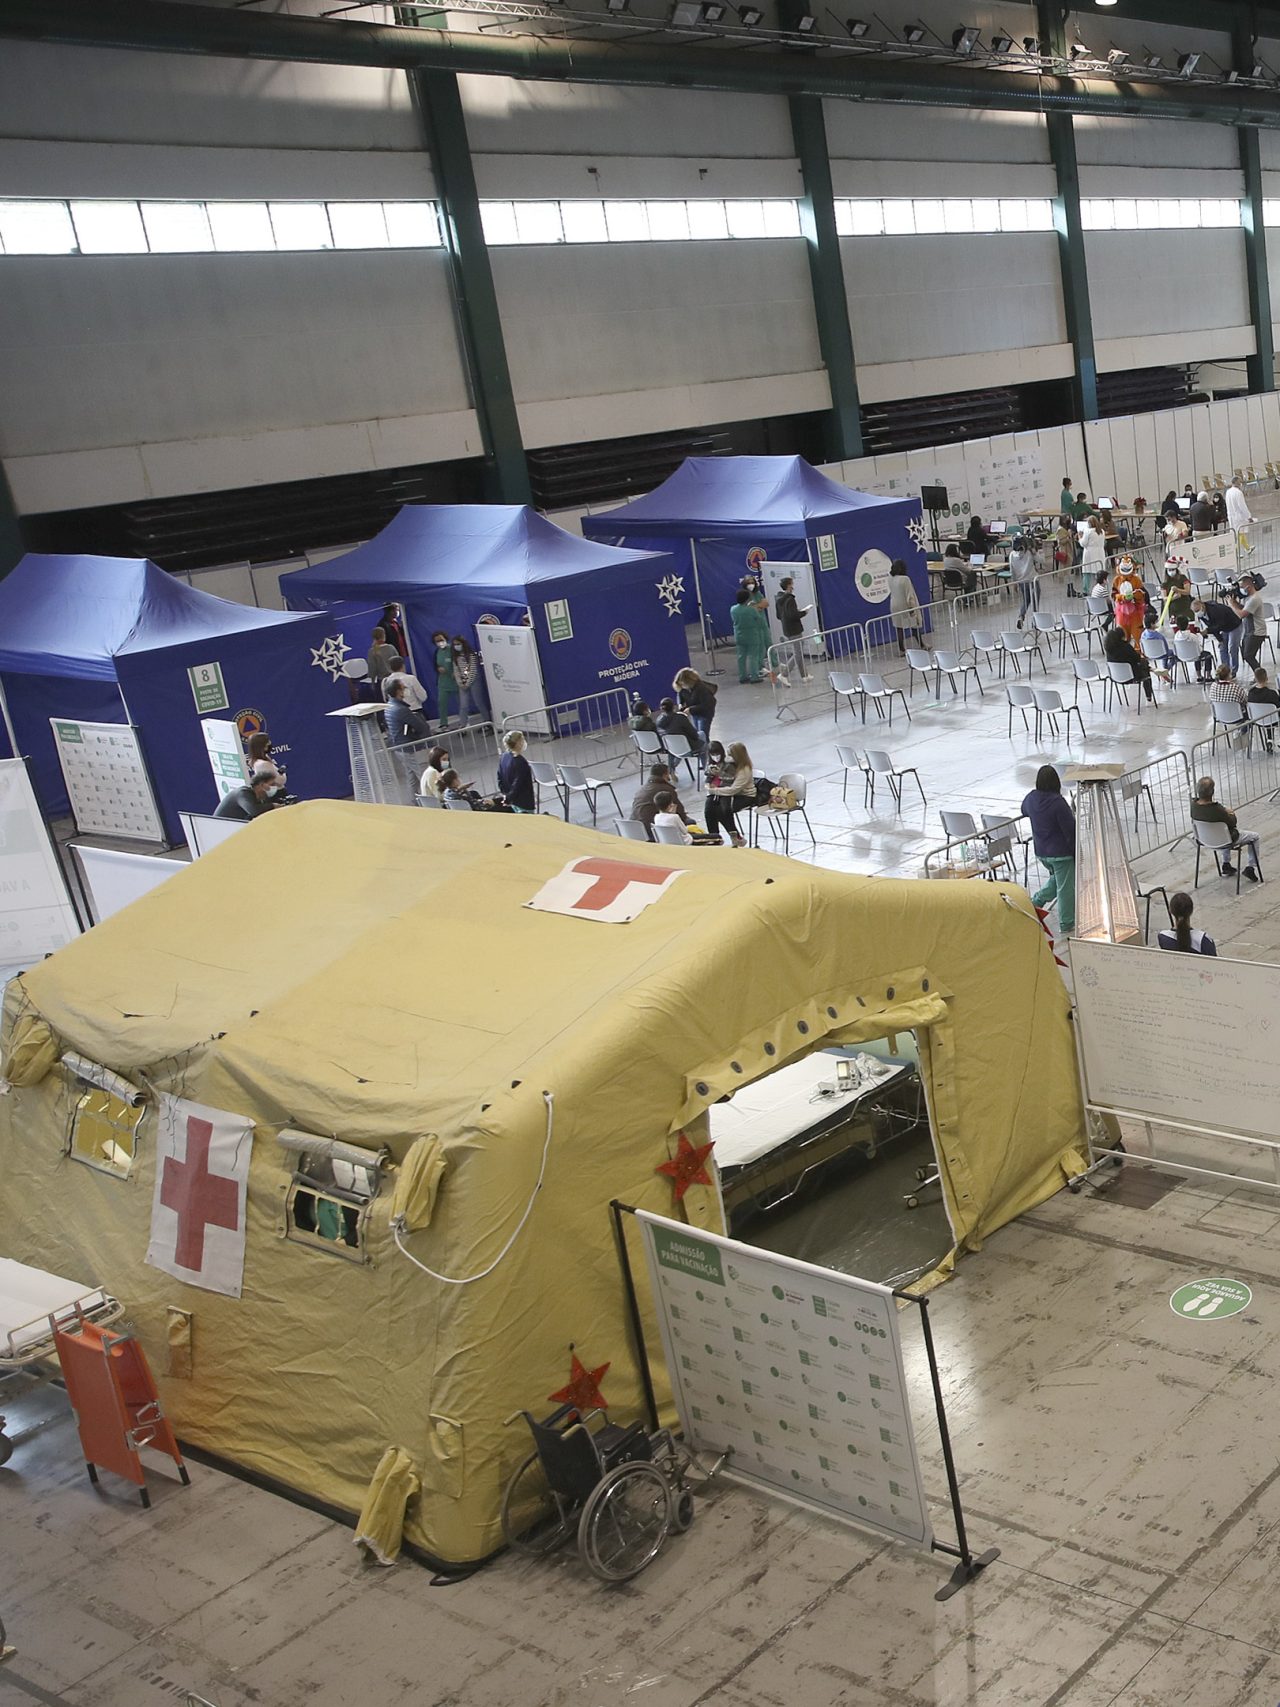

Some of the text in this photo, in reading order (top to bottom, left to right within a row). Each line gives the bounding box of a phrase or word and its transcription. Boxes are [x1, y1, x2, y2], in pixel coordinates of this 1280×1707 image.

[823, 538, 828, 548] 6
[553, 604, 559, 616] 7
[598, 659, 650, 679] PROTEÇÃO CIVIL
[201, 669, 210, 682] 8
[614, 670, 640, 682] MADEIRA
[270, 744, 291, 755] CIVIL
[669, 1240, 705, 1262] ADMISSÃO
[661, 1250, 719, 1277] PARA VACINAÇÃO
[1191, 1284, 1246, 1301] AGUARDE AQUI
[1220, 1285, 1236, 1293] SUA
